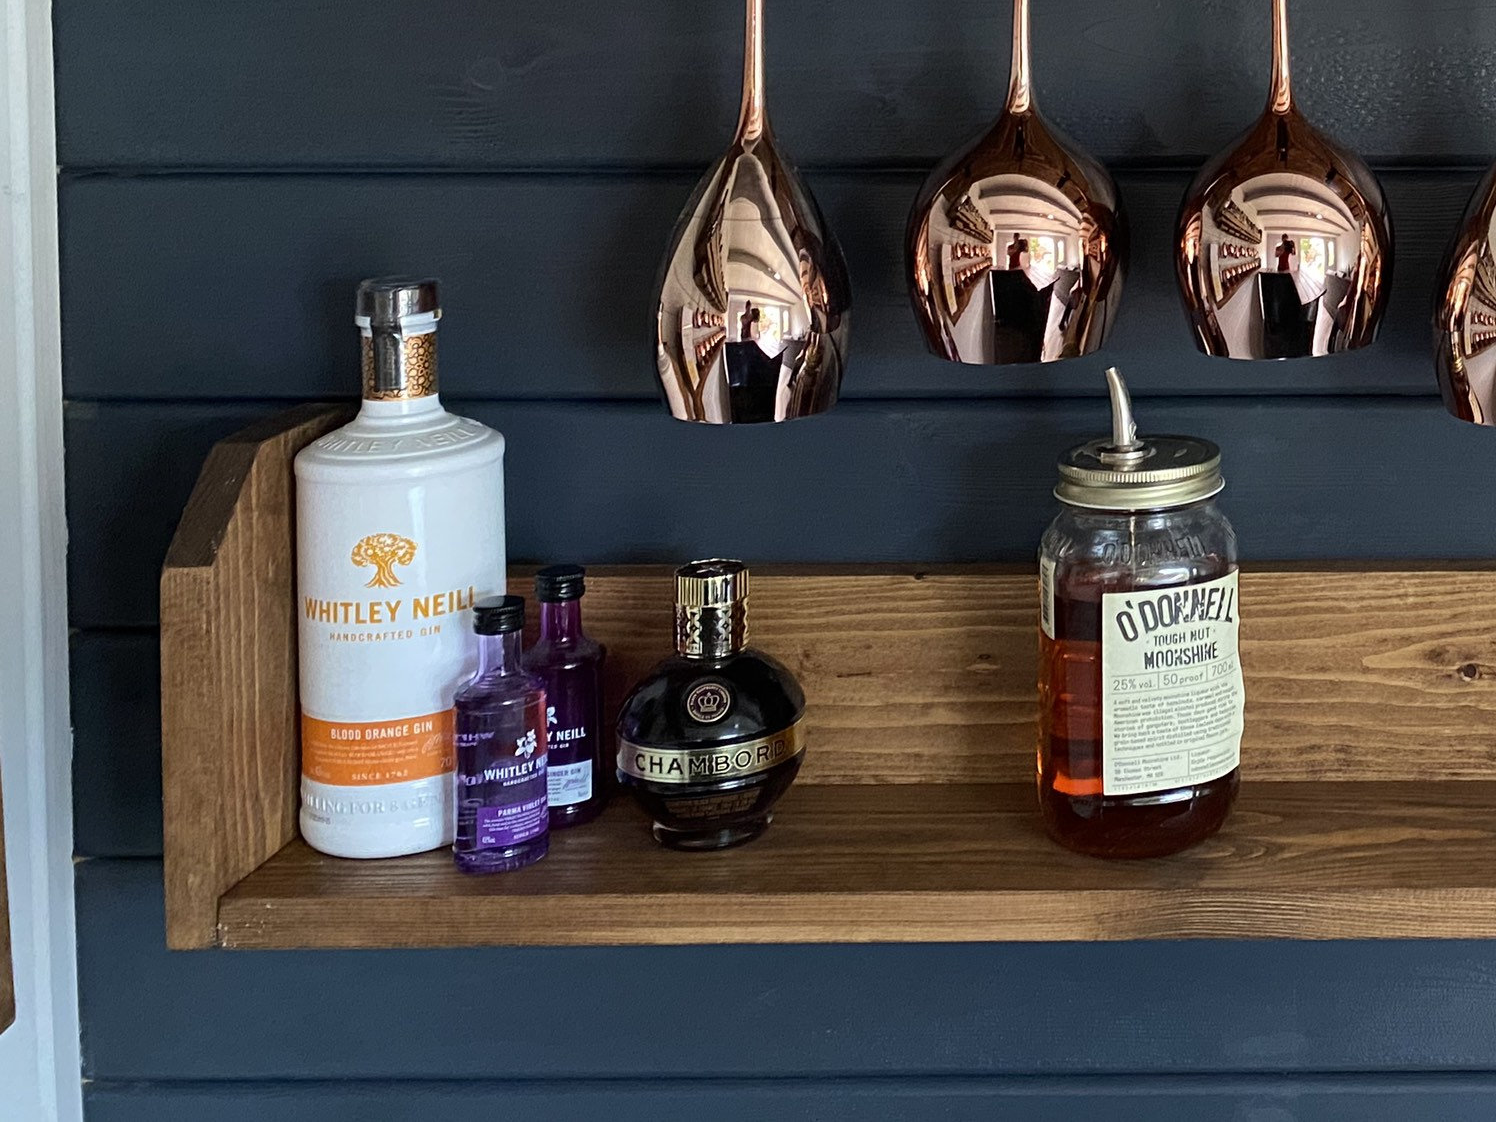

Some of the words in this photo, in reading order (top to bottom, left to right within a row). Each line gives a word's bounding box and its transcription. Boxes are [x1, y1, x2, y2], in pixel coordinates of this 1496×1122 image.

[304, 596, 401, 624] WHITLEY
[413, 586, 475, 620] NEILL
[330, 629, 412, 642] HANDCRAFTED
[420, 625, 441, 637] GIN
[1154, 633, 1186, 647] TOUGH
[1190, 627, 1210, 642] NUT
[1144, 641, 1218, 670] MOONSHINE
[1113, 678, 1137, 691] 25%
[1163, 673, 1178, 686] 50
[1180, 673, 1203, 685] proof
[331, 729, 361, 740] BLOOD
[365, 725, 409, 740] ORANGE
[414, 721, 433, 734] GIN
[556, 727, 586, 742] NEILL
[635, 740, 785, 776] CHAMBORD
[352, 773, 382, 781] SINCE
[484, 761, 534, 781] WHITLEY
